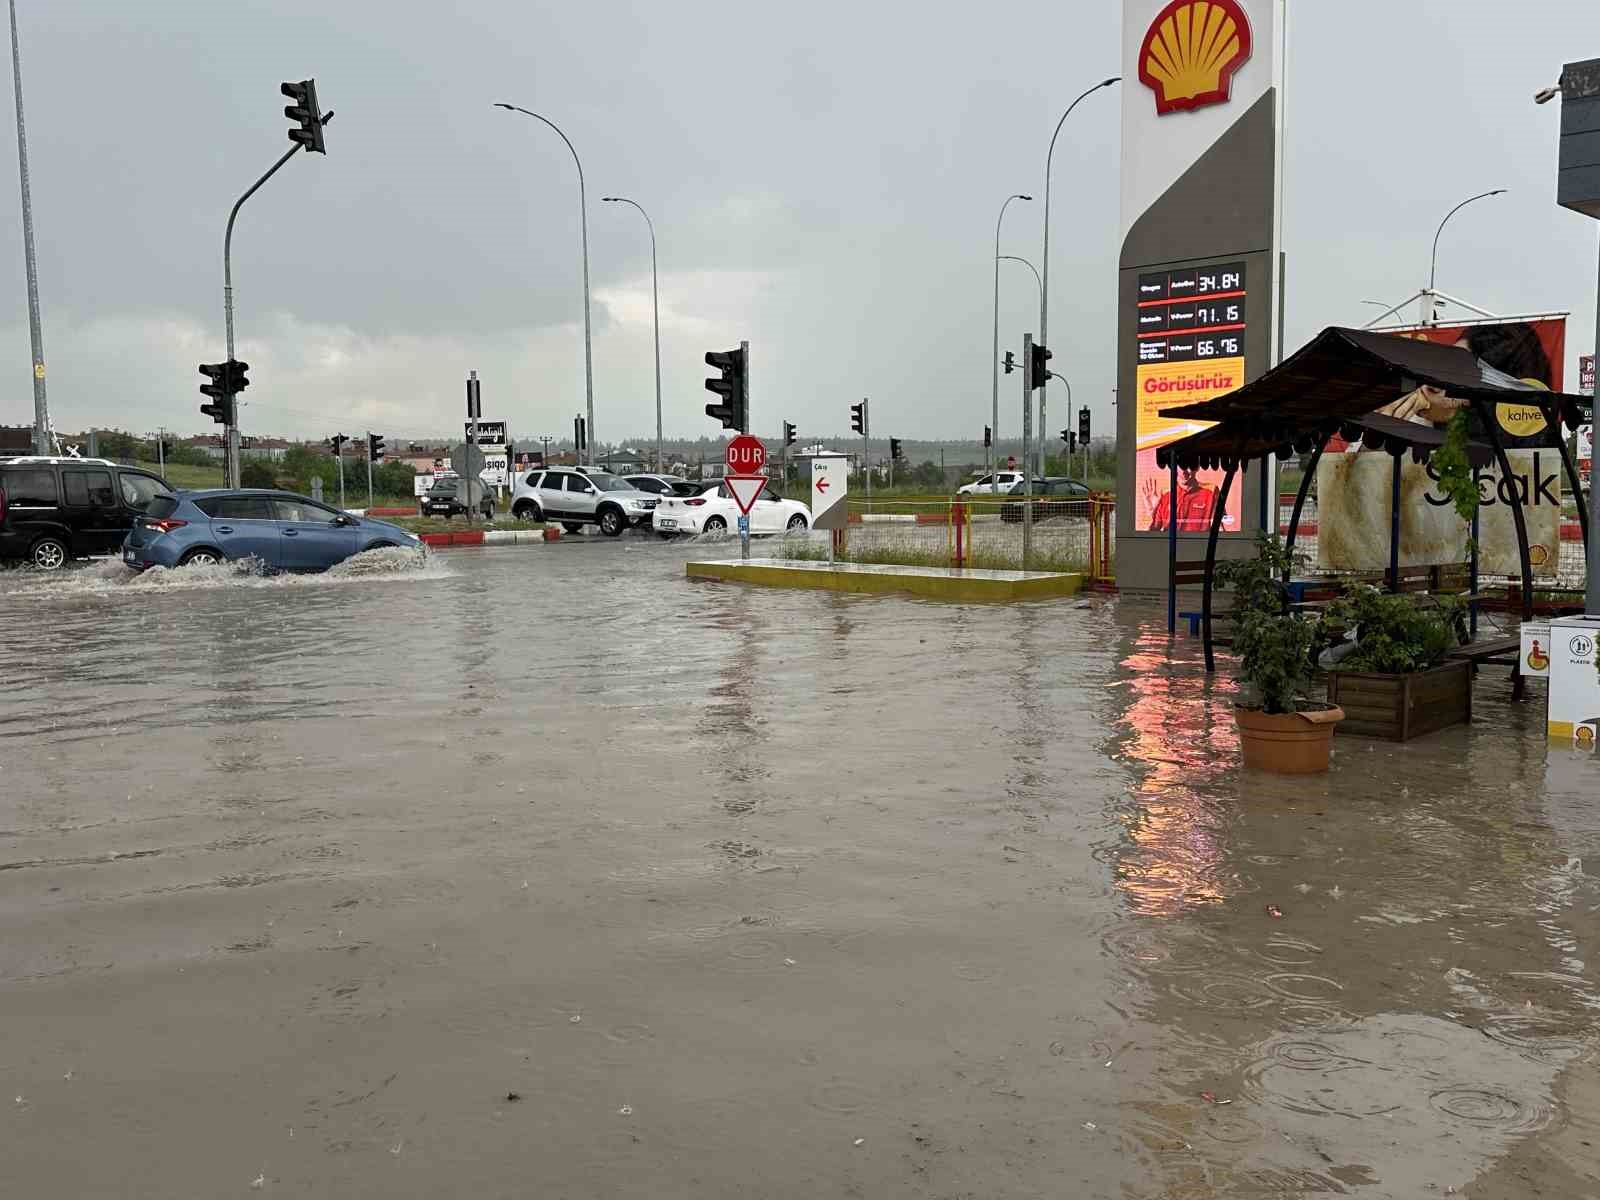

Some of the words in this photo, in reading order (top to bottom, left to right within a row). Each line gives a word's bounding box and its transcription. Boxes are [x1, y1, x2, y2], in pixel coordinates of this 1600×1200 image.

[1200, 273, 1239, 291] 34.84
[1197, 338, 1238, 355] 66.76
[1144, 373, 1232, 394] Görüşürüz
[1507, 407, 1542, 421] kahve
[729, 448, 762, 463] DUR
[1424, 452, 1560, 506] Scak
